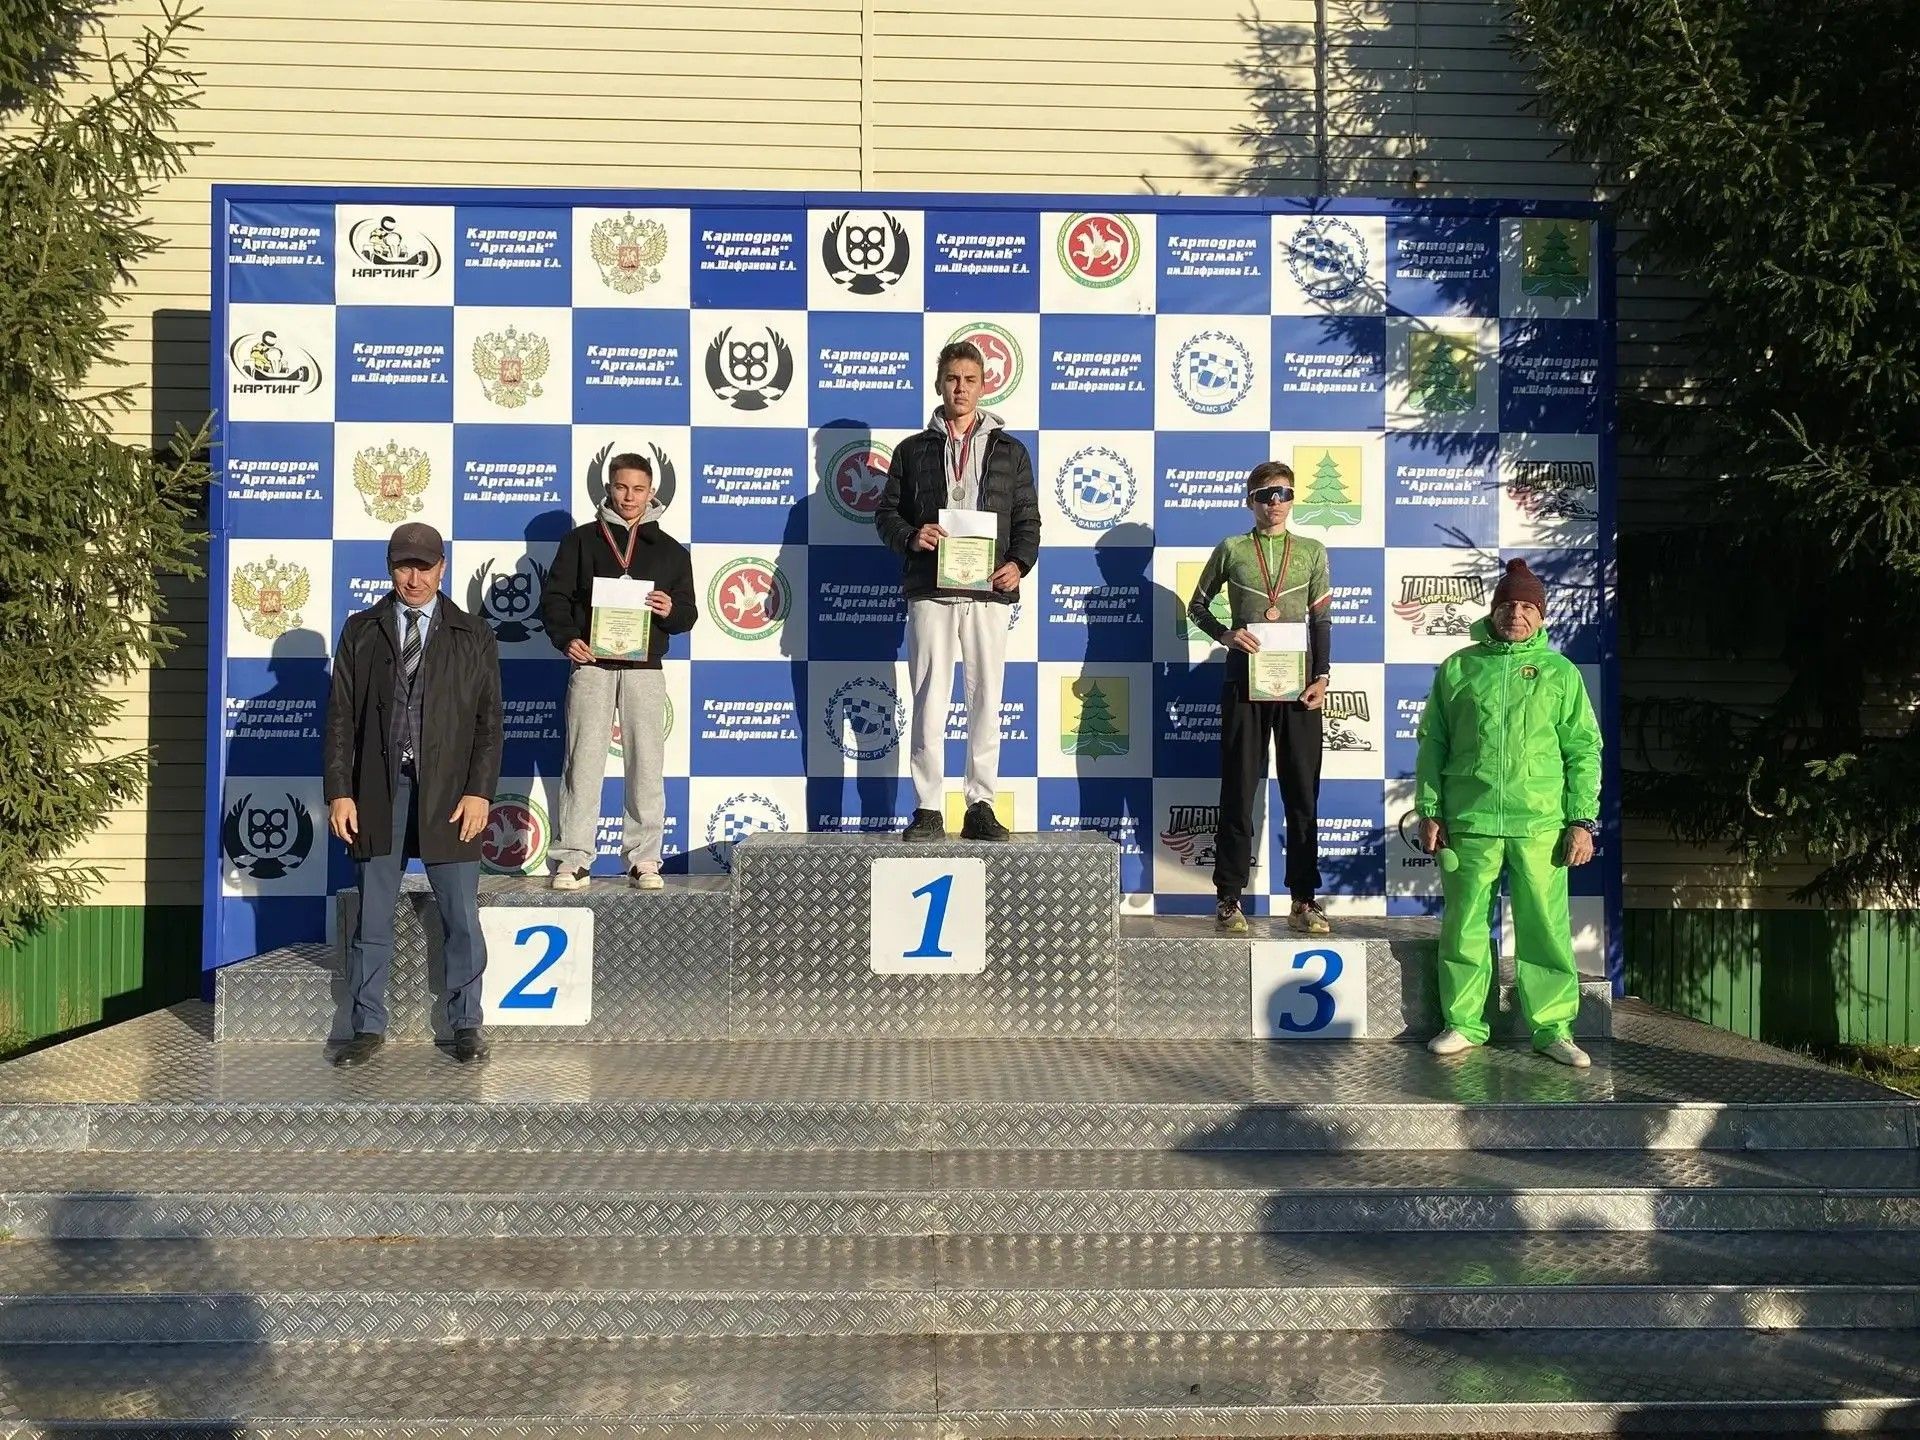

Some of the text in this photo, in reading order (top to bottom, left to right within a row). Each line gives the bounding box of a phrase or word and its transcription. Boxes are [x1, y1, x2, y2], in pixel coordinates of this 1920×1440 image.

[229, 225, 319, 238] Картодром
[467, 228, 557, 241] Картодром
[702, 231, 792, 244] Картодром
[936, 234, 1026, 247] Картодром
[1168, 237, 1256, 249] Картодром
[306, 255, 323, 264] Е.А.
[544, 258, 561, 267] Е.А.
[779, 261, 796, 270] Е.А.
[1013, 264, 1030, 273] Е.А.
[1244, 266, 1260, 275] Е.А.
[352, 269, 419, 278] КАРТИНГ
[1473, 269, 1489, 278] Е.А.
[352, 343, 444, 356] Картодром
[587, 346, 677, 359] Картодром
[819, 350, 909, 363] Картодром
[1053, 352, 1141, 364] Картодром
[1285, 353, 1373, 365] Картодром
[431, 374, 448, 383] Е.А.
[664, 376, 681, 385] Е.А.
[233, 384, 300, 394] КАРТИНГ
[896, 380, 913, 389] Е.А.
[1129, 381, 1145, 390] Е.А.
[1361, 382, 1377, 391] Е.А.
[1194, 403, 1230, 413] ФАМС РТ
[228, 460, 318, 473] Картодром
[466, 462, 556, 475] Картодром
[703, 465, 793, 478] Картодром
[1396, 467, 1484, 479] Картодром
[305, 490, 322, 499] Е.А.
[543, 492, 560, 501] Е.А.
[780, 495, 797, 504] Е.А.
[1472, 496, 1488, 505] Е.А.
[1078, 518, 1114, 528] ФАМС РТ
[1051, 585, 1139, 597] Картодром
[1402, 576, 1486, 606] TORNADO
[1420, 594, 1465, 605] КАРТИНГ
[1127, 614, 1143, 623] Е.А.
[224, 698, 316, 711] Картодром
[703, 700, 793, 713] Картодром
[1322, 709, 1350, 720] ТИНГ
[303, 728, 320, 738] Е.А.
[780, 730, 797, 739] Е.А.
[848, 750, 883, 759] ФАМС РТ
[819, 815, 907, 827] Картодром
[1170, 806, 1220, 835] TORN
[1188, 824, 1218, 834] КАРТ
[1402, 858, 1437, 867] КАРТ
[902, 874, 954, 958] 1
[499, 924, 569, 1009] 2
[1278, 949, 1344, 1032] 3
